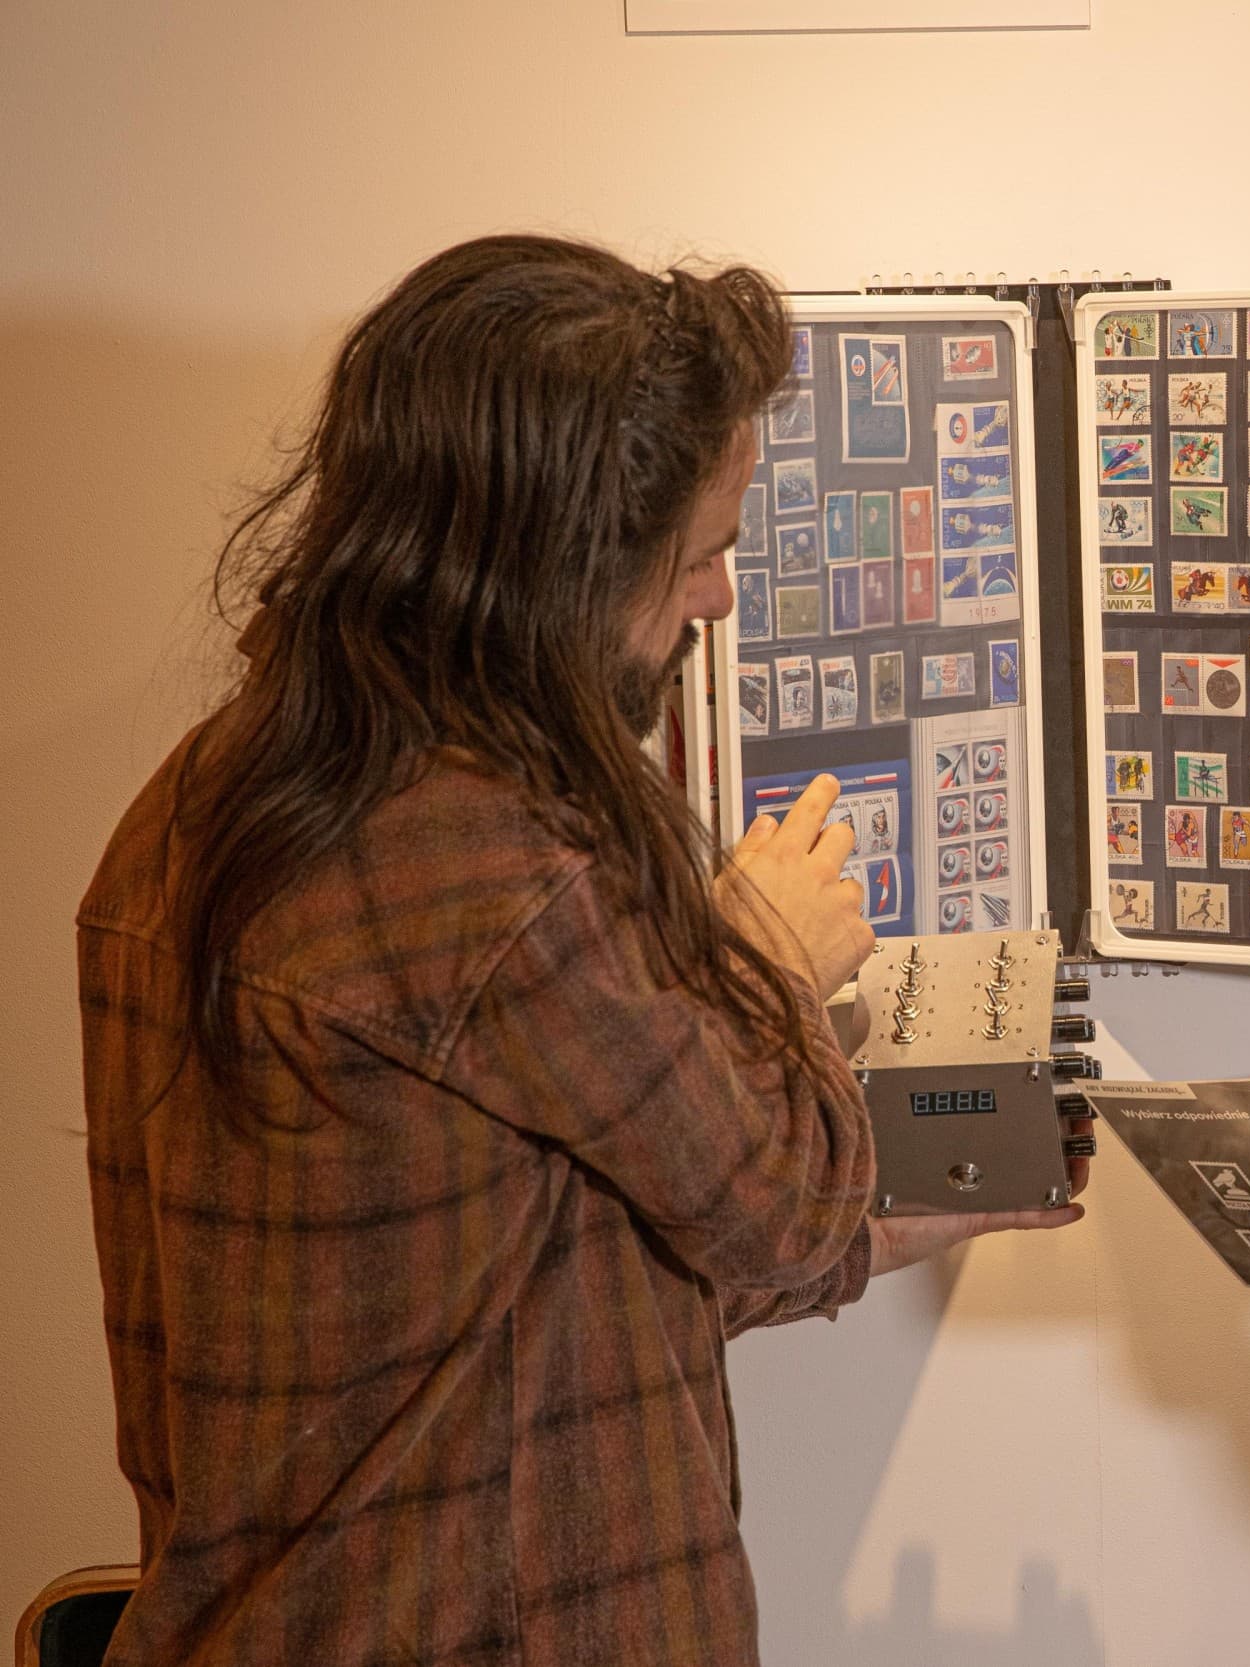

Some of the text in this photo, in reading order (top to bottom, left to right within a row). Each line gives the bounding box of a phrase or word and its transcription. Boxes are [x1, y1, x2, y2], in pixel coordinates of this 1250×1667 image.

[1107, 600, 1153, 610] WM 74
[1121, 1109, 1174, 1121] Wybierz
[1174, 1110, 1250, 1122] odpowiednie
